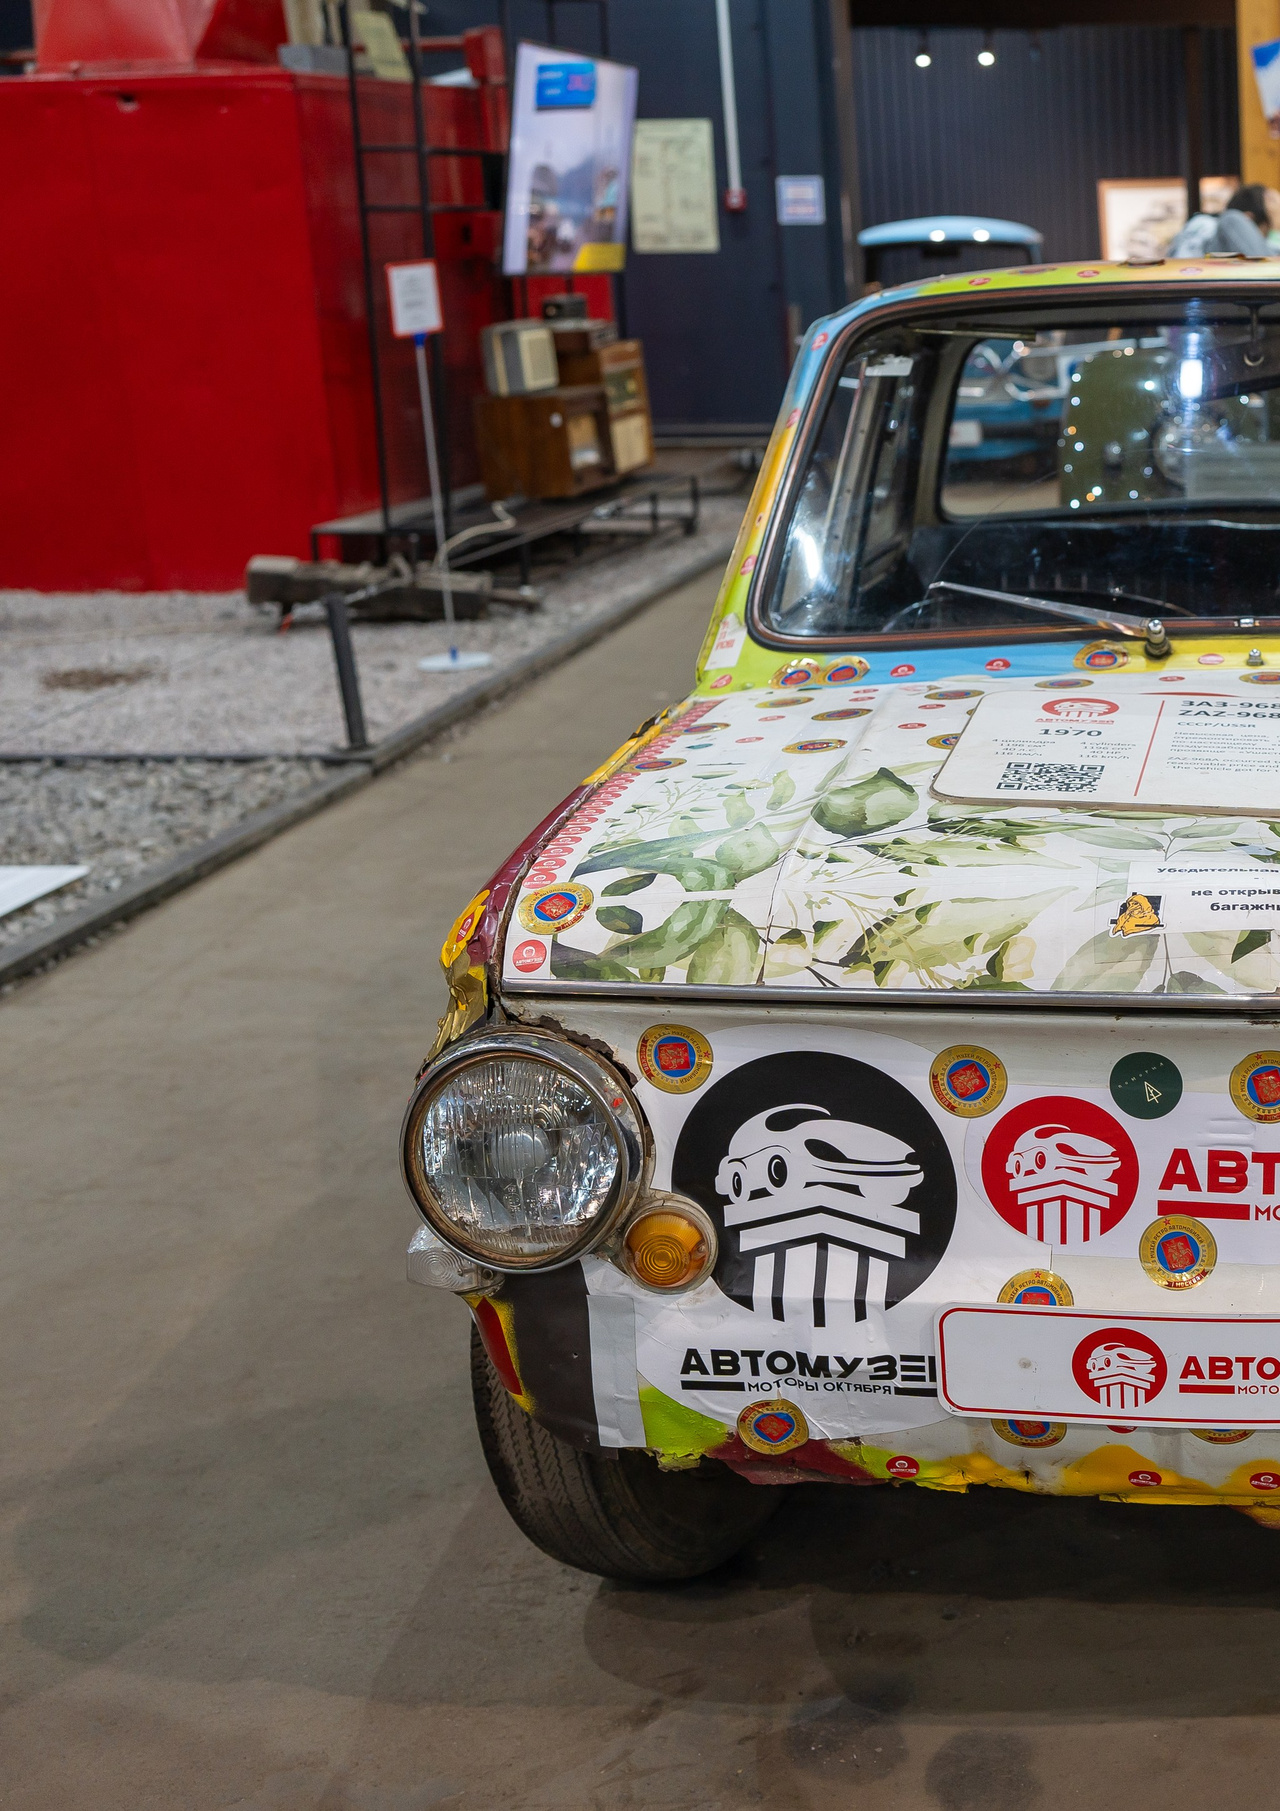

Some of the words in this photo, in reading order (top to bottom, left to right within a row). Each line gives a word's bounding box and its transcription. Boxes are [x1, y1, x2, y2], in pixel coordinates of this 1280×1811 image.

[1039, 728, 1103, 737] 1970
[1191, 889, 1213, 897] не
[933, 1082, 949, 1106] МОСКВА
[748, 1377, 819, 1392] МОТОРЫ
[824, 1381, 892, 1395] ОКТЯБРЯ
